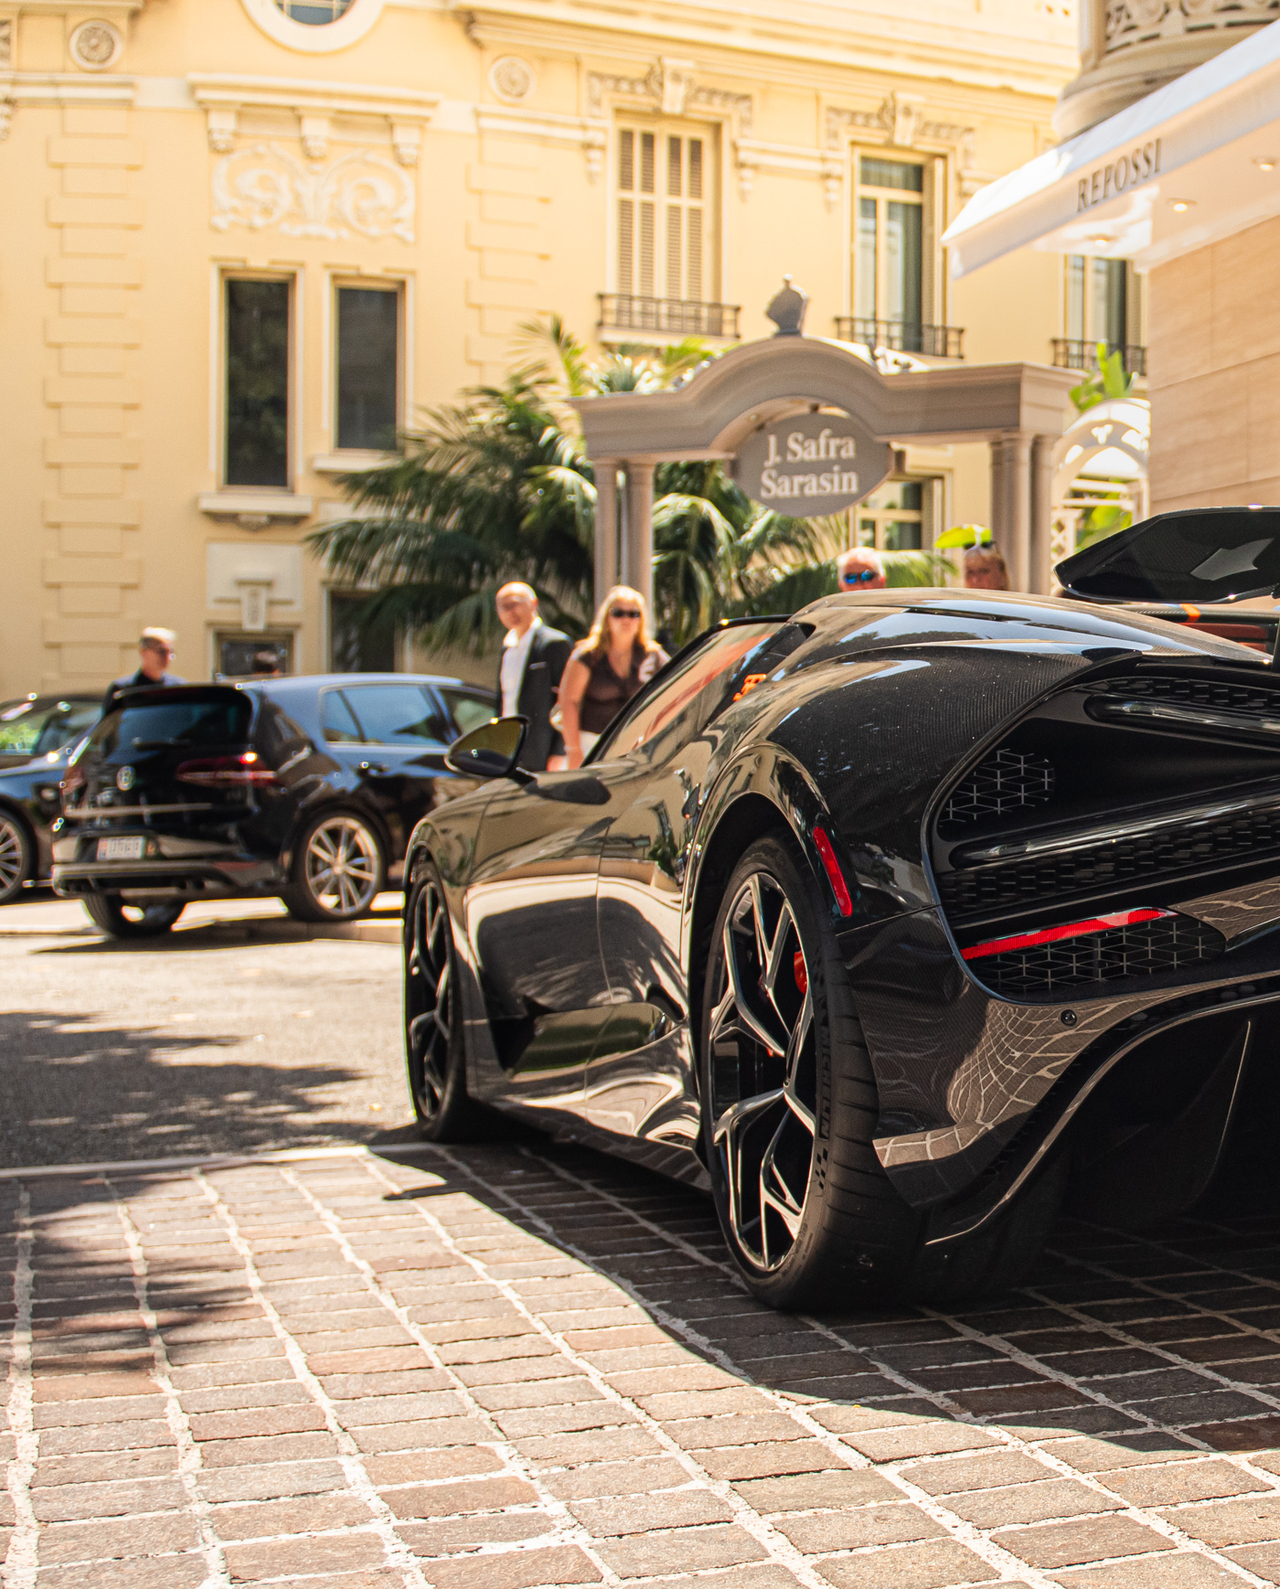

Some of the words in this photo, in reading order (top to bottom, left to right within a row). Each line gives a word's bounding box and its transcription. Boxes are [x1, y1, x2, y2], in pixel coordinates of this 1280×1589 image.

[1077, 137, 1162, 213] REPOSSI
[764, 434, 783, 468] J.
[786, 428, 856, 464] Safra
[760, 465, 859, 500] Sarasin
